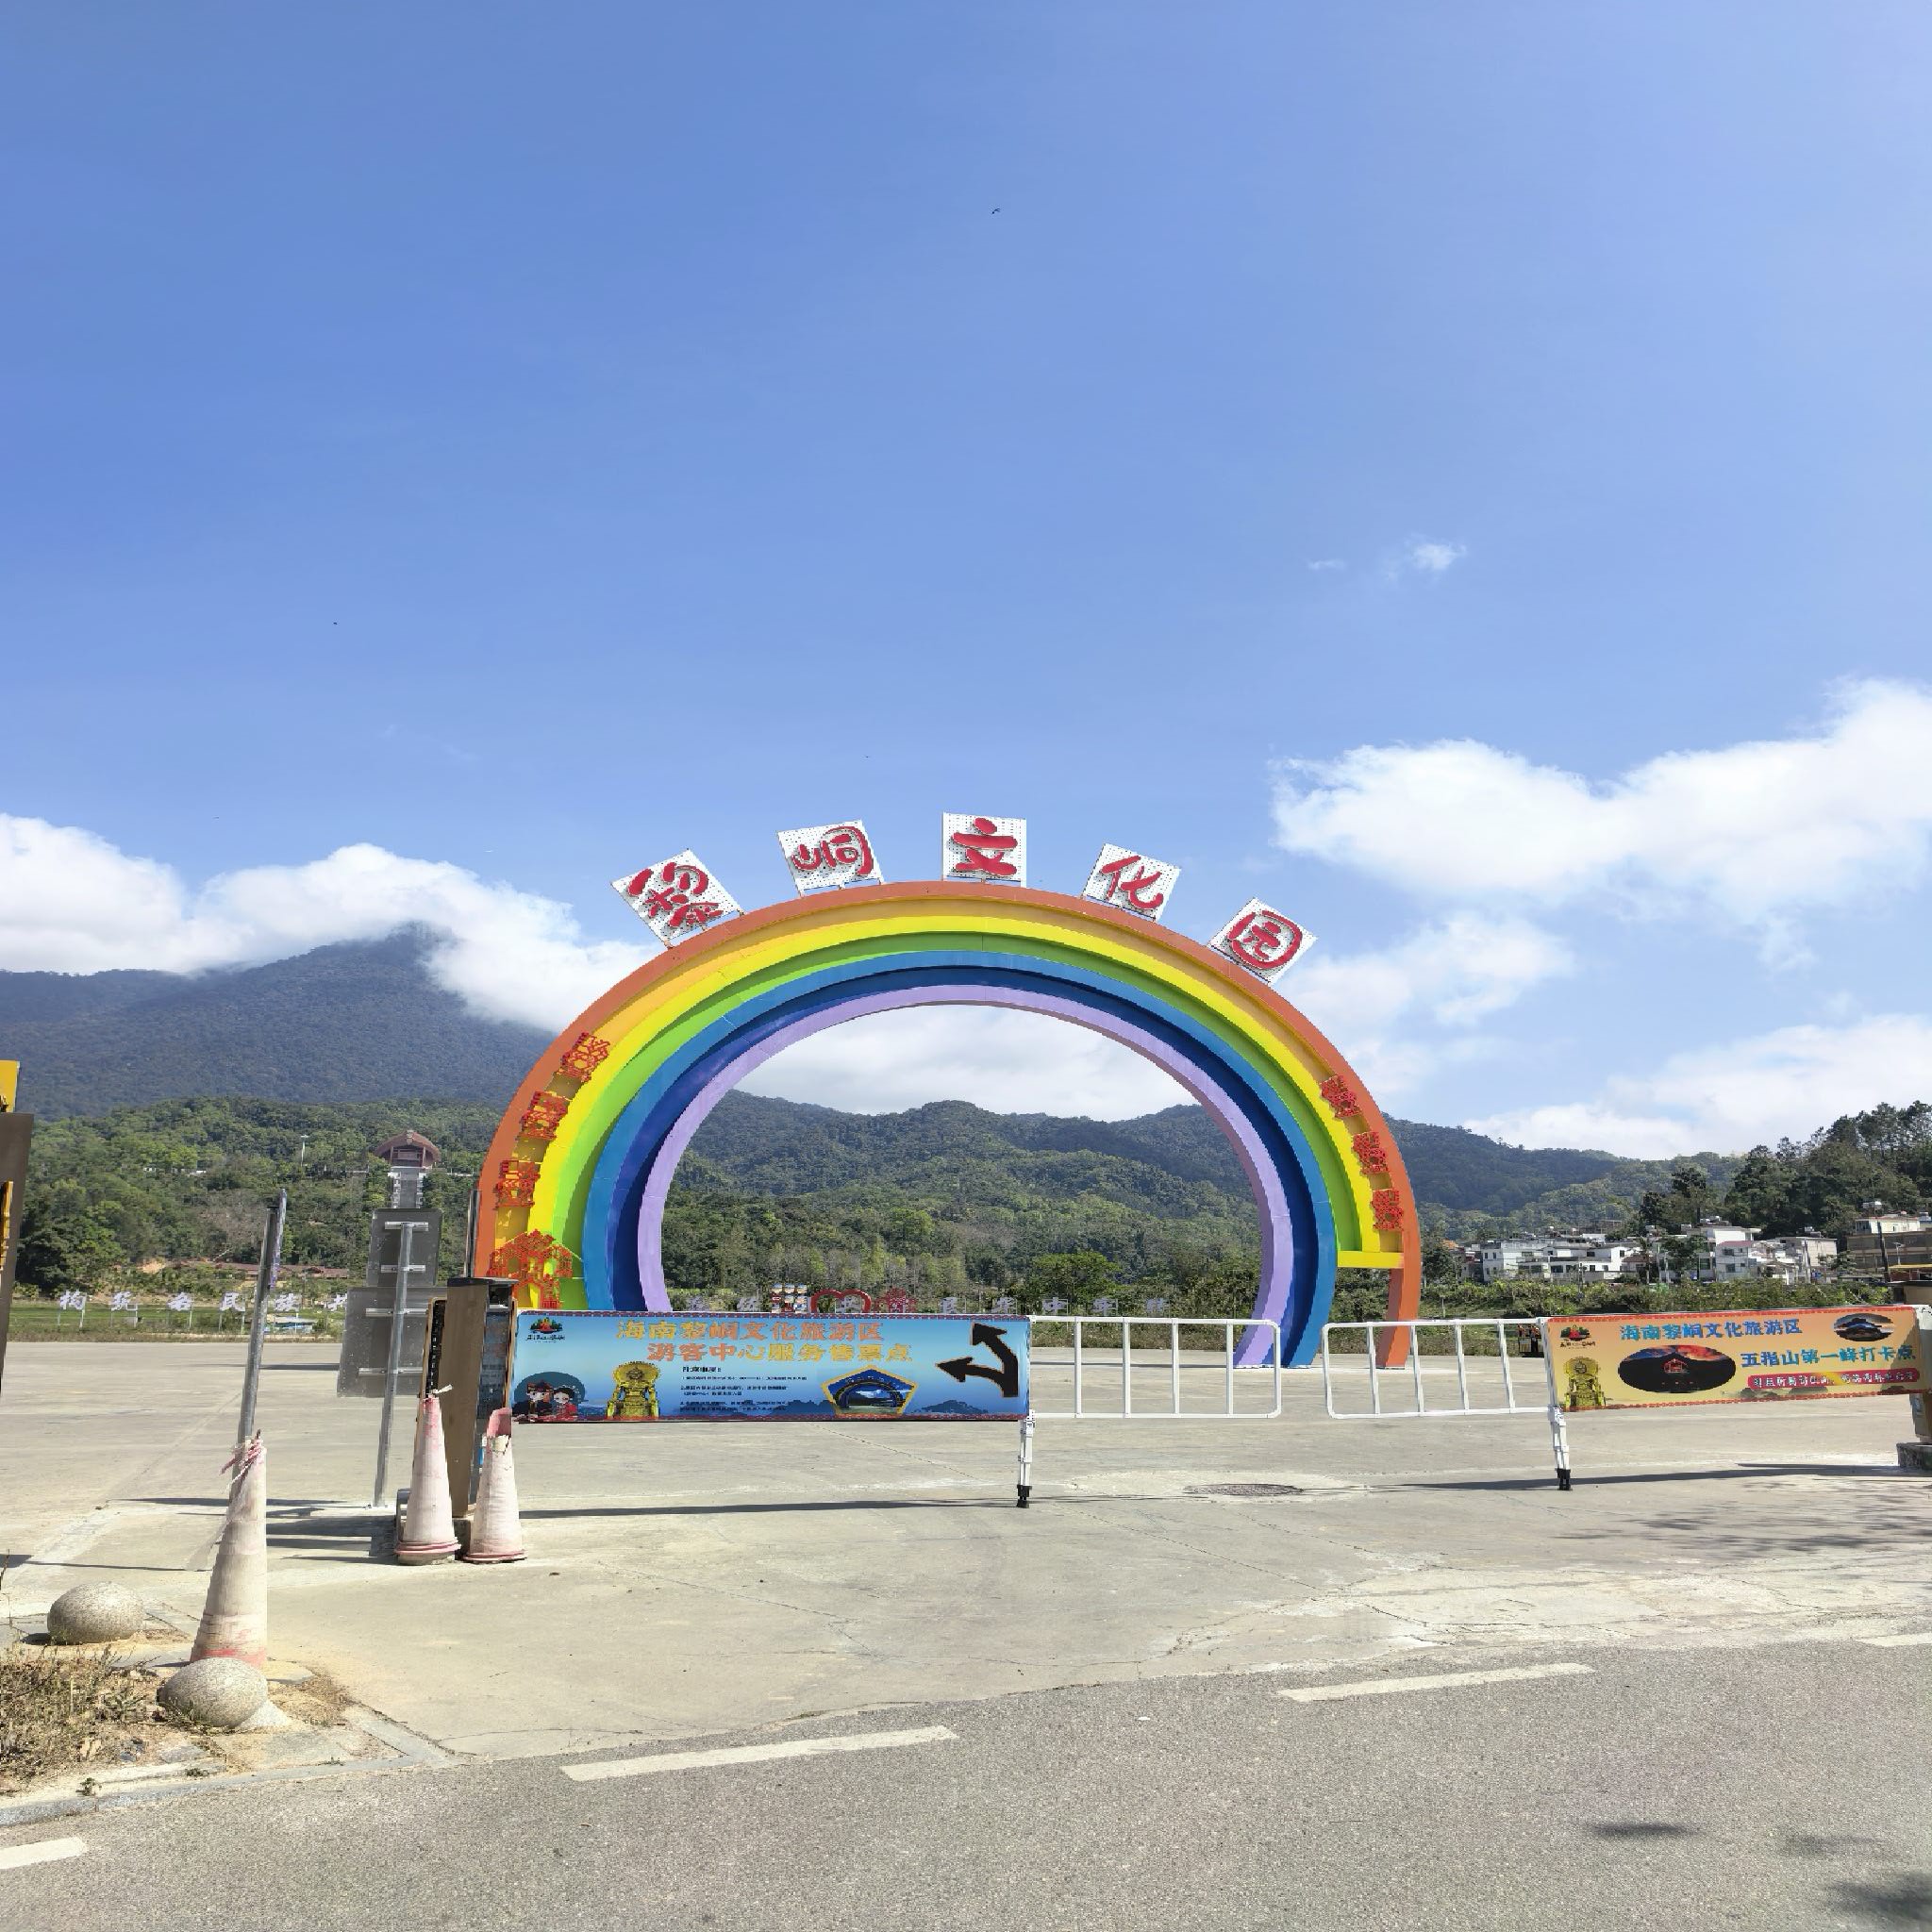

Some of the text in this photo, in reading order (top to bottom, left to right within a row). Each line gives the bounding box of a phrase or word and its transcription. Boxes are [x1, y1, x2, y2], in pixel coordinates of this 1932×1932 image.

[626, 815, 1303, 973] 黎峒文化园
[615, 1321, 885, 1341] 海南黎峒文化旅游区
[1619, 1318, 1803, 1341] 海南黎峒文化旅游区
[646, 1342, 913, 1363] 游客中心服务售票点
[1740, 1344, 1917, 1368] 五指山第一峰打卡点
